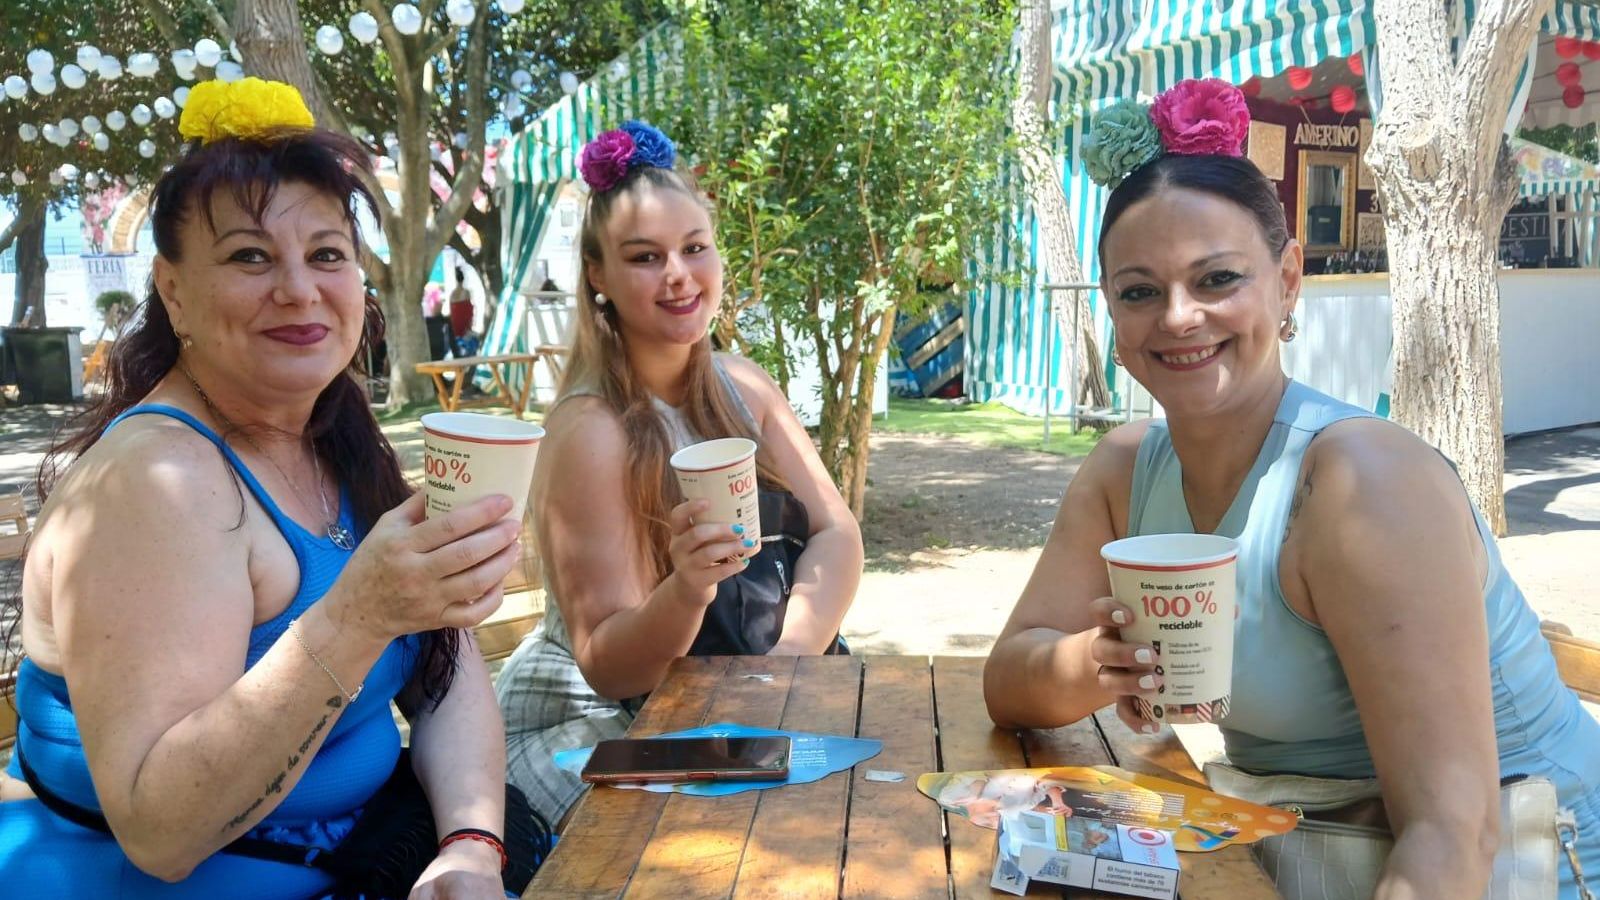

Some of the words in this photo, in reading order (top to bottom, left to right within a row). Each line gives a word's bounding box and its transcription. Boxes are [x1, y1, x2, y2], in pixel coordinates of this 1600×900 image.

[1294, 123, 1360, 147] AMERINO
[425, 452, 447, 479] 00
[1140, 582, 1155, 590] Este
[1174, 583, 1183, 591] de
[1159, 620, 1203, 630] reciclable
